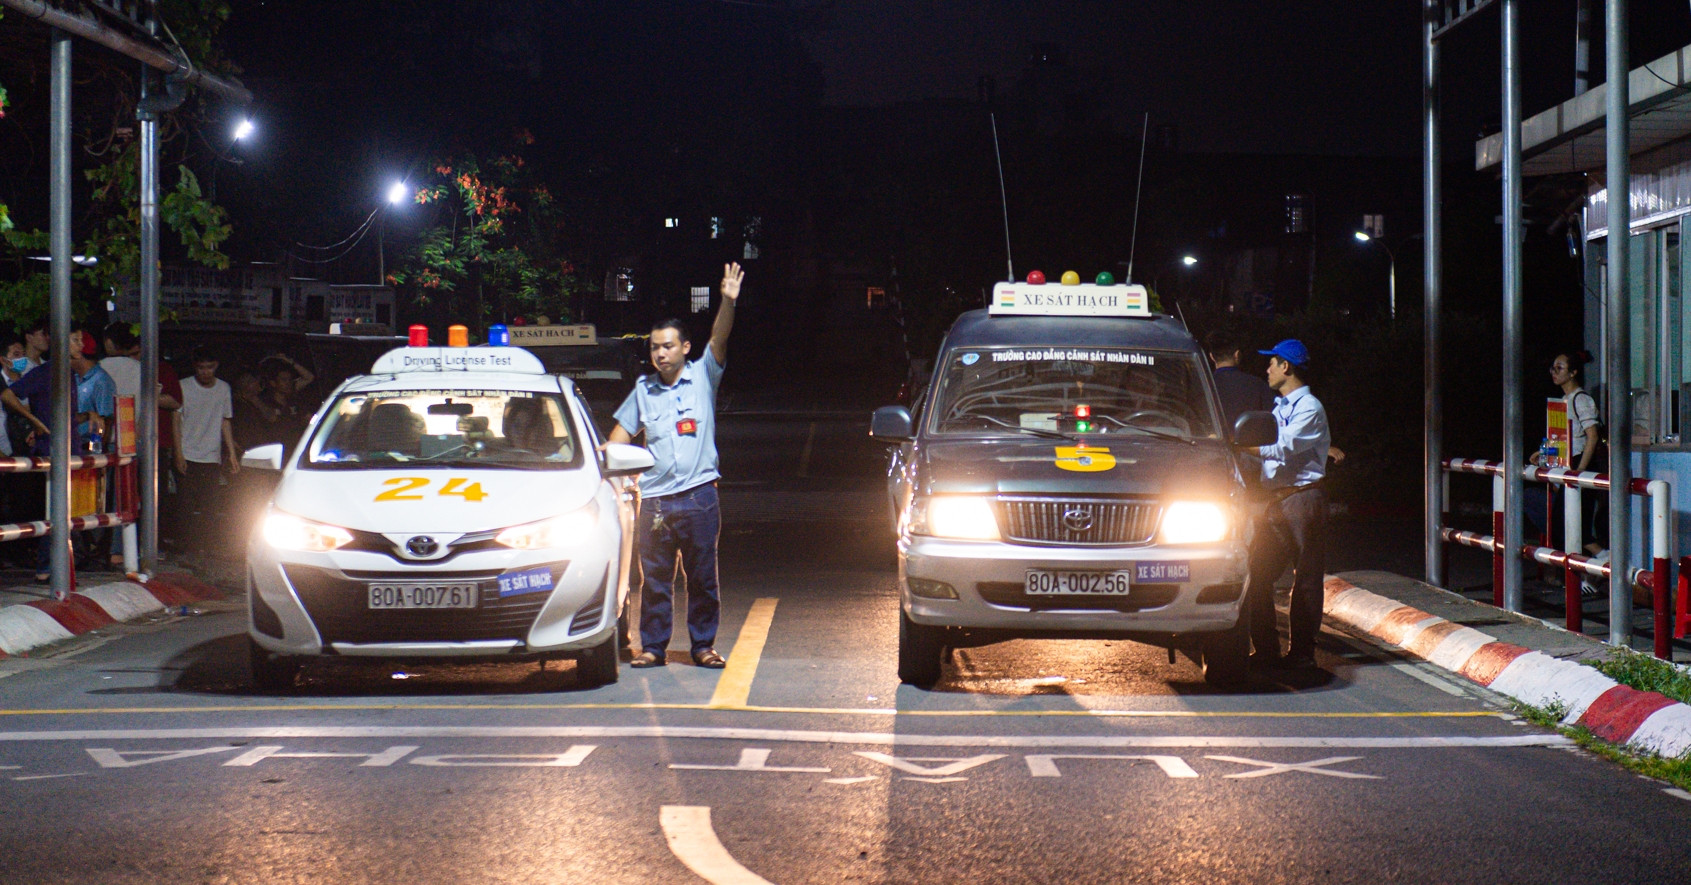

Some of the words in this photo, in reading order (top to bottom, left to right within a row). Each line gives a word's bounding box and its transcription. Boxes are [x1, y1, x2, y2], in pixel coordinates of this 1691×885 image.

[1024, 294, 1043, 306] XE
[1046, 292, 1074, 306] SÁT
[1077, 295, 1118, 309] HẠCH
[513, 330, 524, 338] XE
[404, 355, 441, 369] Driving
[445, 354, 486, 366] License
[489, 354, 511, 366] Test
[992, 349, 1025, 362] TRƯỜNG
[1025, 351, 1043, 361] CAO
[1066, 349, 1089, 361] CẢNH
[1090, 350, 1105, 362] SÁT
[1148, 356, 1154, 365] II
[400, 390, 419, 398] CAO
[1055, 446, 1116, 472] 5
[373, 477, 489, 502] 24
[1138, 566, 1148, 578] XE
[1150, 563, 1165, 578] SÁT
[1167, 565, 1189, 580] HẠCH
[499, 579, 512, 592] XE
[512, 574, 528, 590] SÁT
[529, 573, 551, 588] HẠCH
[1029, 573, 1126, 593] 80A-002.56
[371, 586, 472, 607] 80A-007.61
